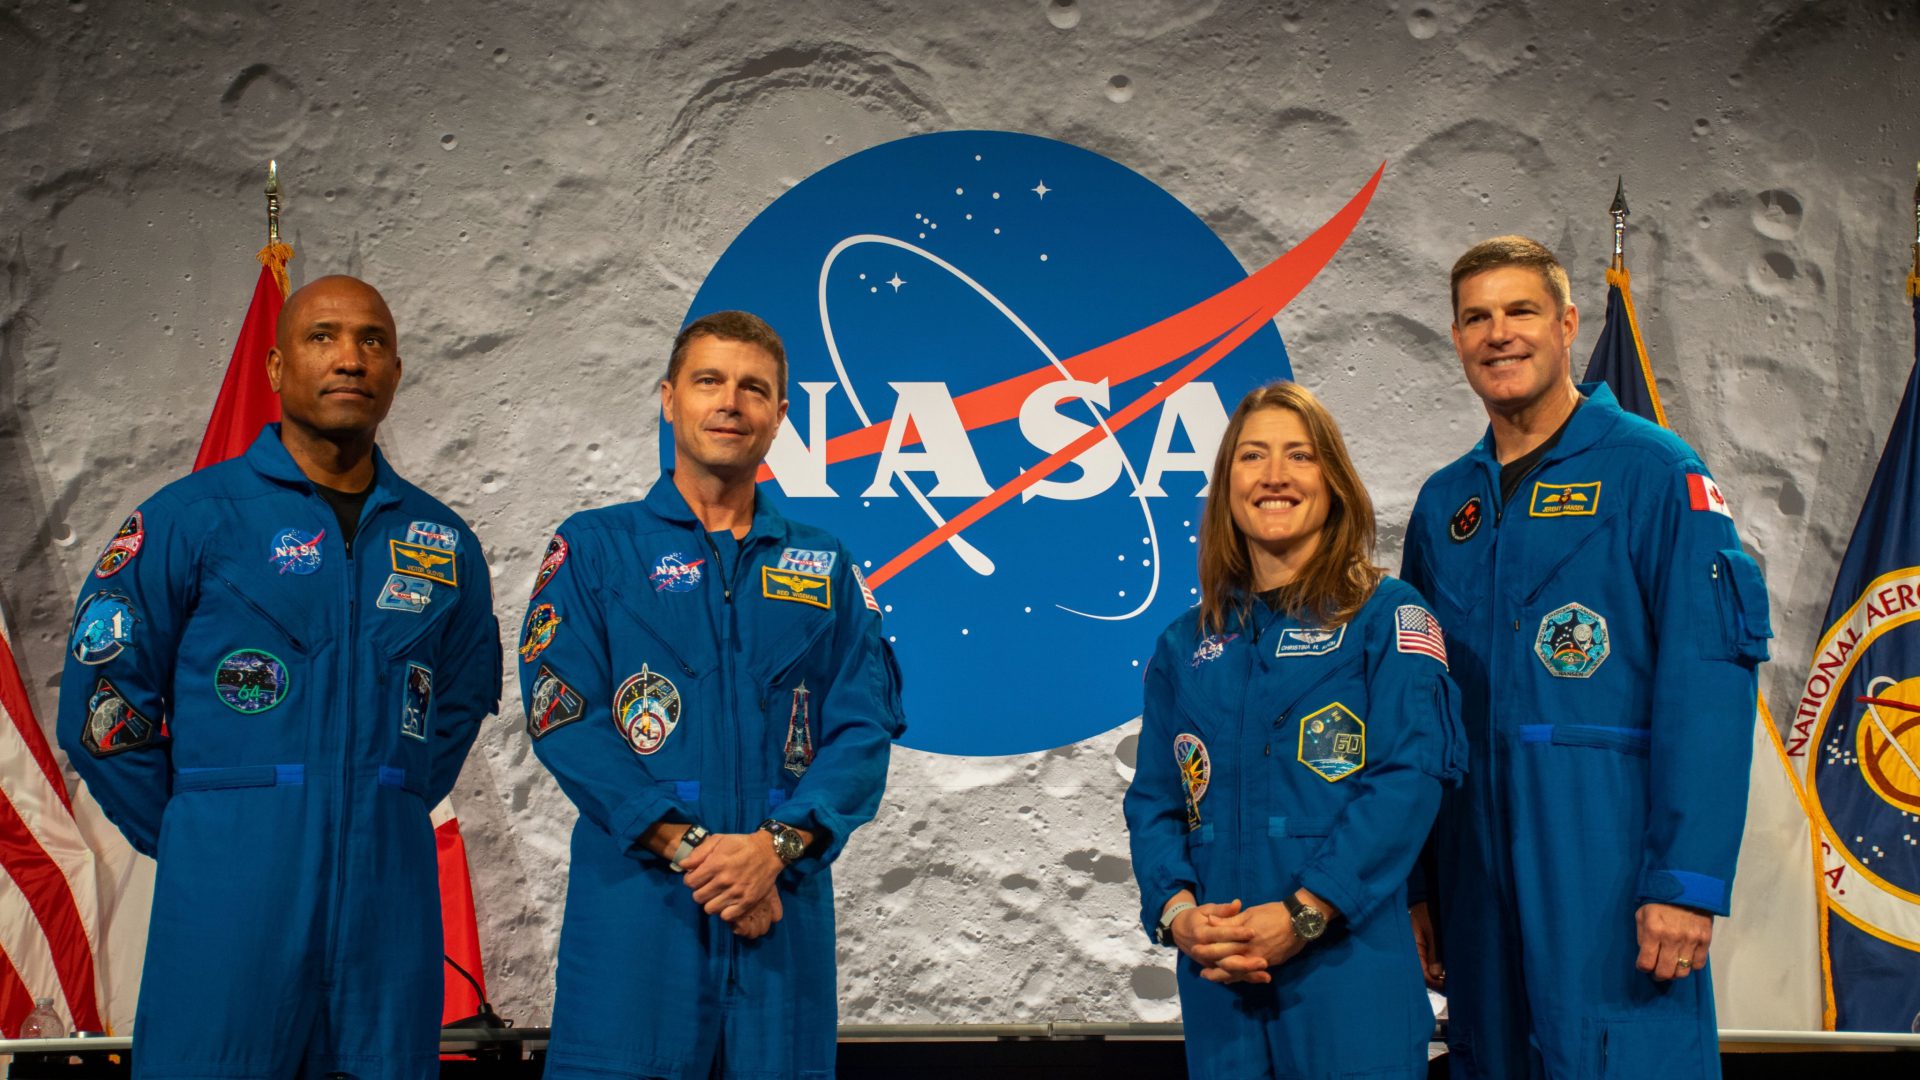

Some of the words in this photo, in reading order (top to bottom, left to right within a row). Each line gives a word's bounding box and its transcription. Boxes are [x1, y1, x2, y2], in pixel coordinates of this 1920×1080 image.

[763, 379, 1230, 504] NASA
[275, 545, 320, 557] NASA
[406, 564, 424, 573] VICTOR
[656, 565, 701, 575] NASA
[776, 589, 790, 597] REID
[792, 591, 818, 602] WISEMAN
[112, 610, 122, 639] 1
[1787, 627, 1863, 757] NATIONAL
[1866, 584, 1920, 627] AER
[238, 684, 260, 700] 64
[1334, 733, 1362, 754] 60
